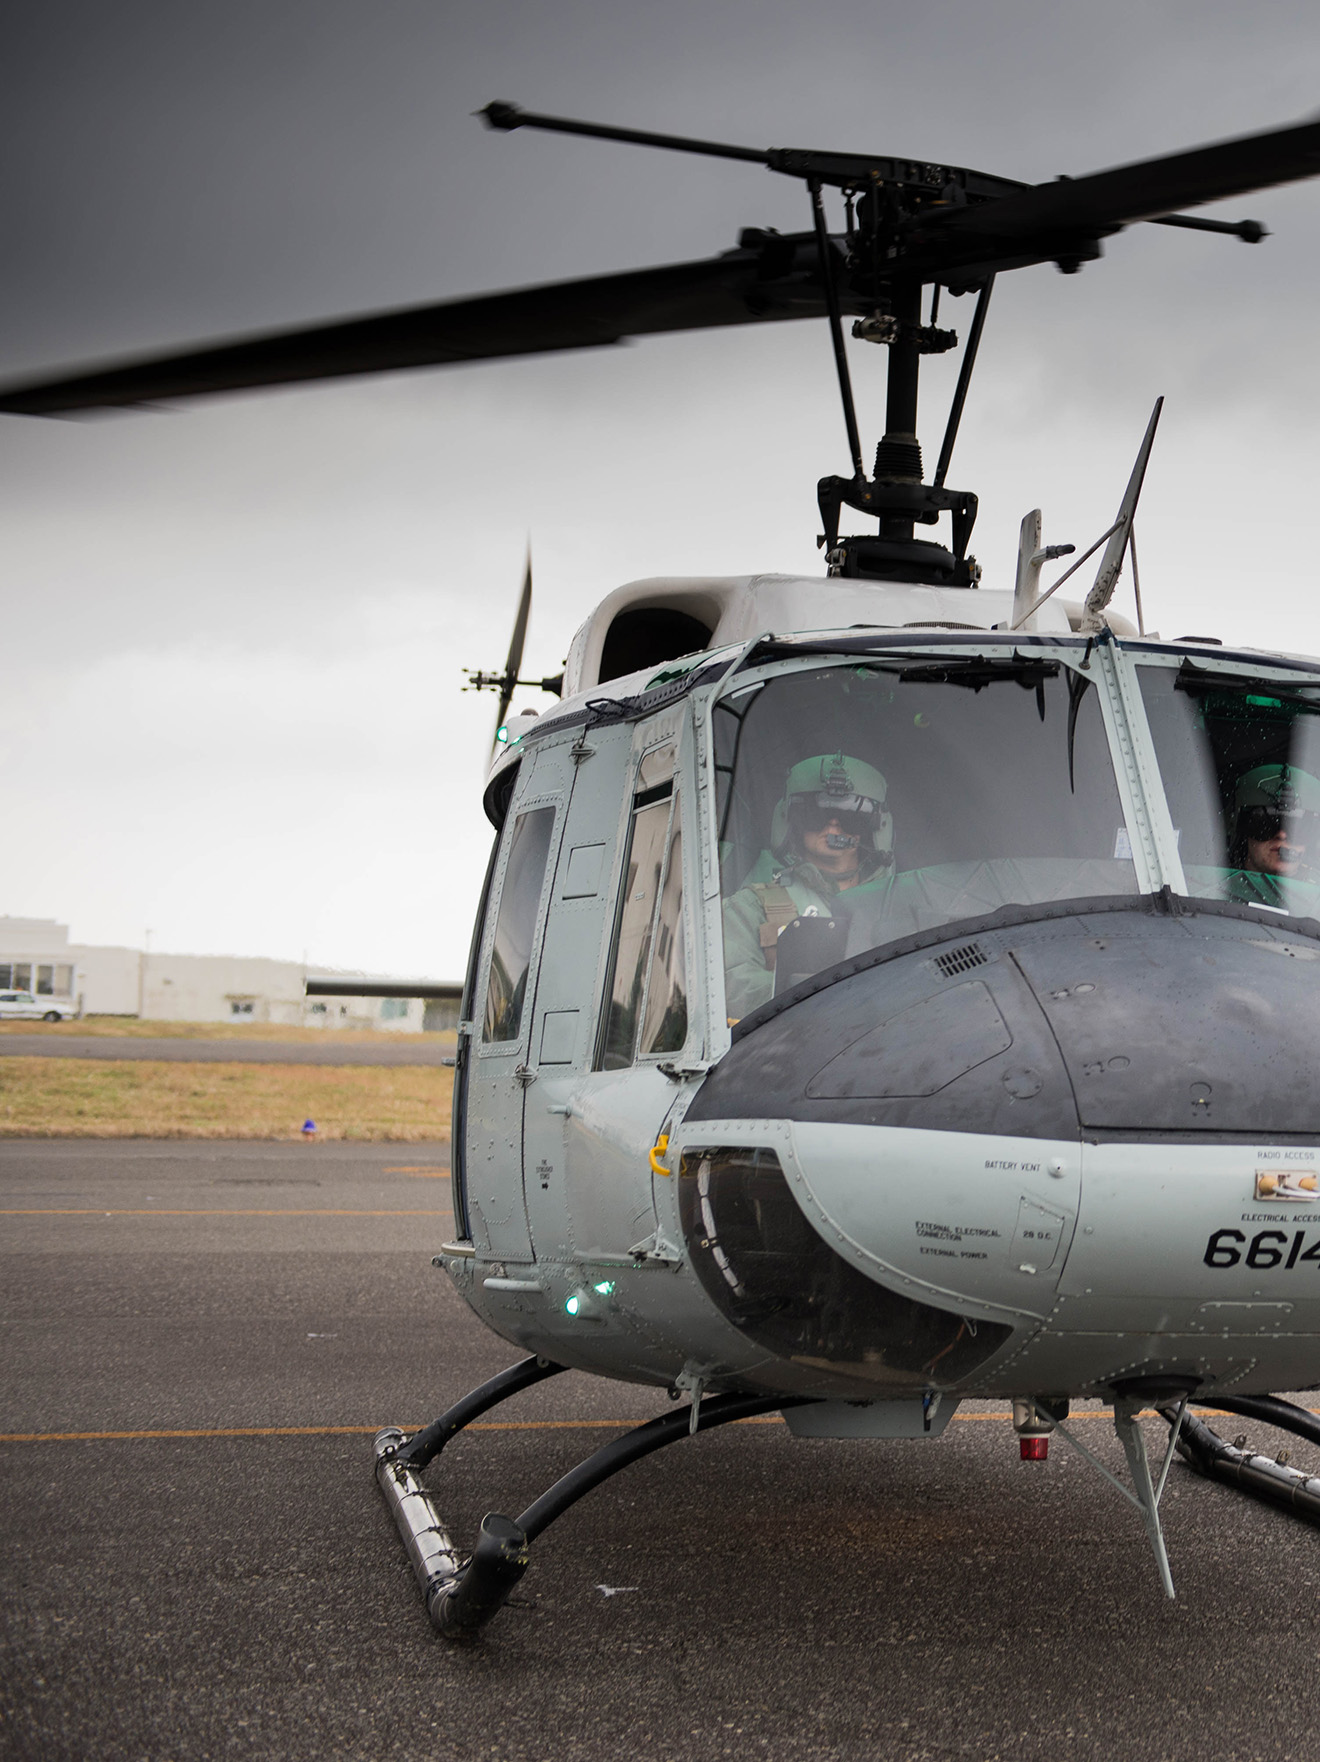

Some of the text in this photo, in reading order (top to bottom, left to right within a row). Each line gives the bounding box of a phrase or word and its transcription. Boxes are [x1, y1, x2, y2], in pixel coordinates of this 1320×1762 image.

[1257, 1151, 1315, 1160] RADIO ACCESS
[985, 1160, 1041, 1172] BATTERY VENT
[1241, 1213, 1289, 1223] ELECTRICAL
[915, 1221, 1002, 1238] EXTERNAL ELECTRICAL
[916, 1229, 962, 1242] CONNECTION
[920, 1247, 988, 1260] EXTERNAL POWER
